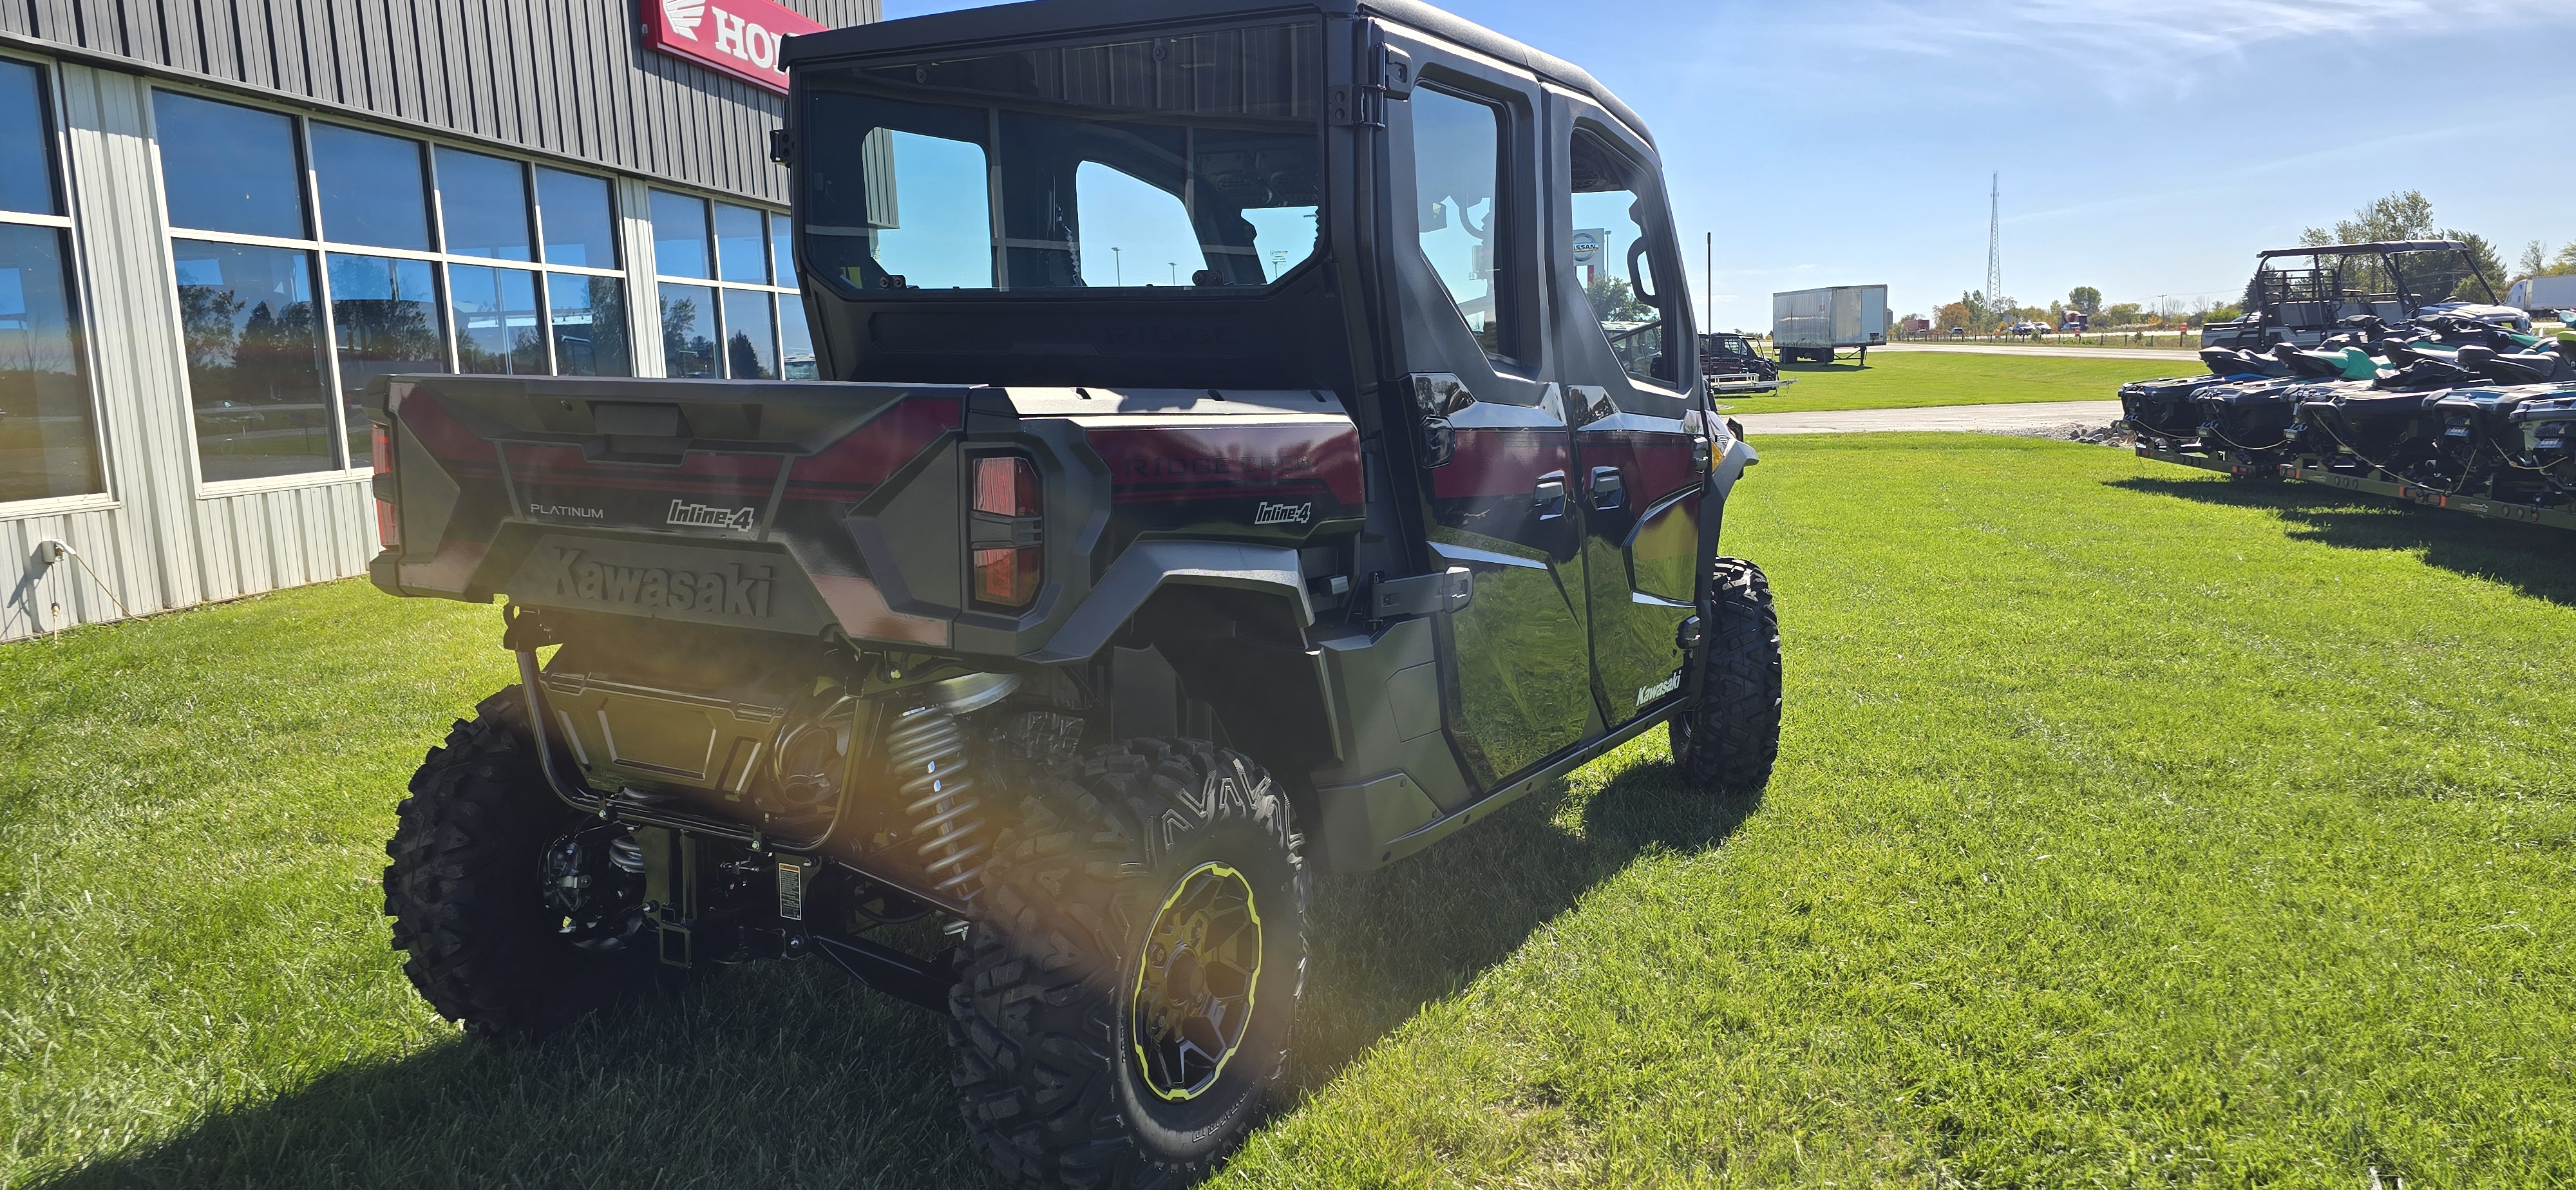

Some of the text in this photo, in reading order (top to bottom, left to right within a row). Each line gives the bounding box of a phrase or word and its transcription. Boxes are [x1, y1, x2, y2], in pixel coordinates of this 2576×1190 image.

[1104, 325, 1238, 344] RIDGE
[1126, 455, 1311, 477] RIDGE CREW
[531, 504, 603, 519] PLATINUM
[666, 498, 755, 533] Inline-4
[1254, 502, 1312, 525] Inline-4
[552, 547, 773, 618] Kawasaki
[1636, 669, 1682, 707] Kawasaki
